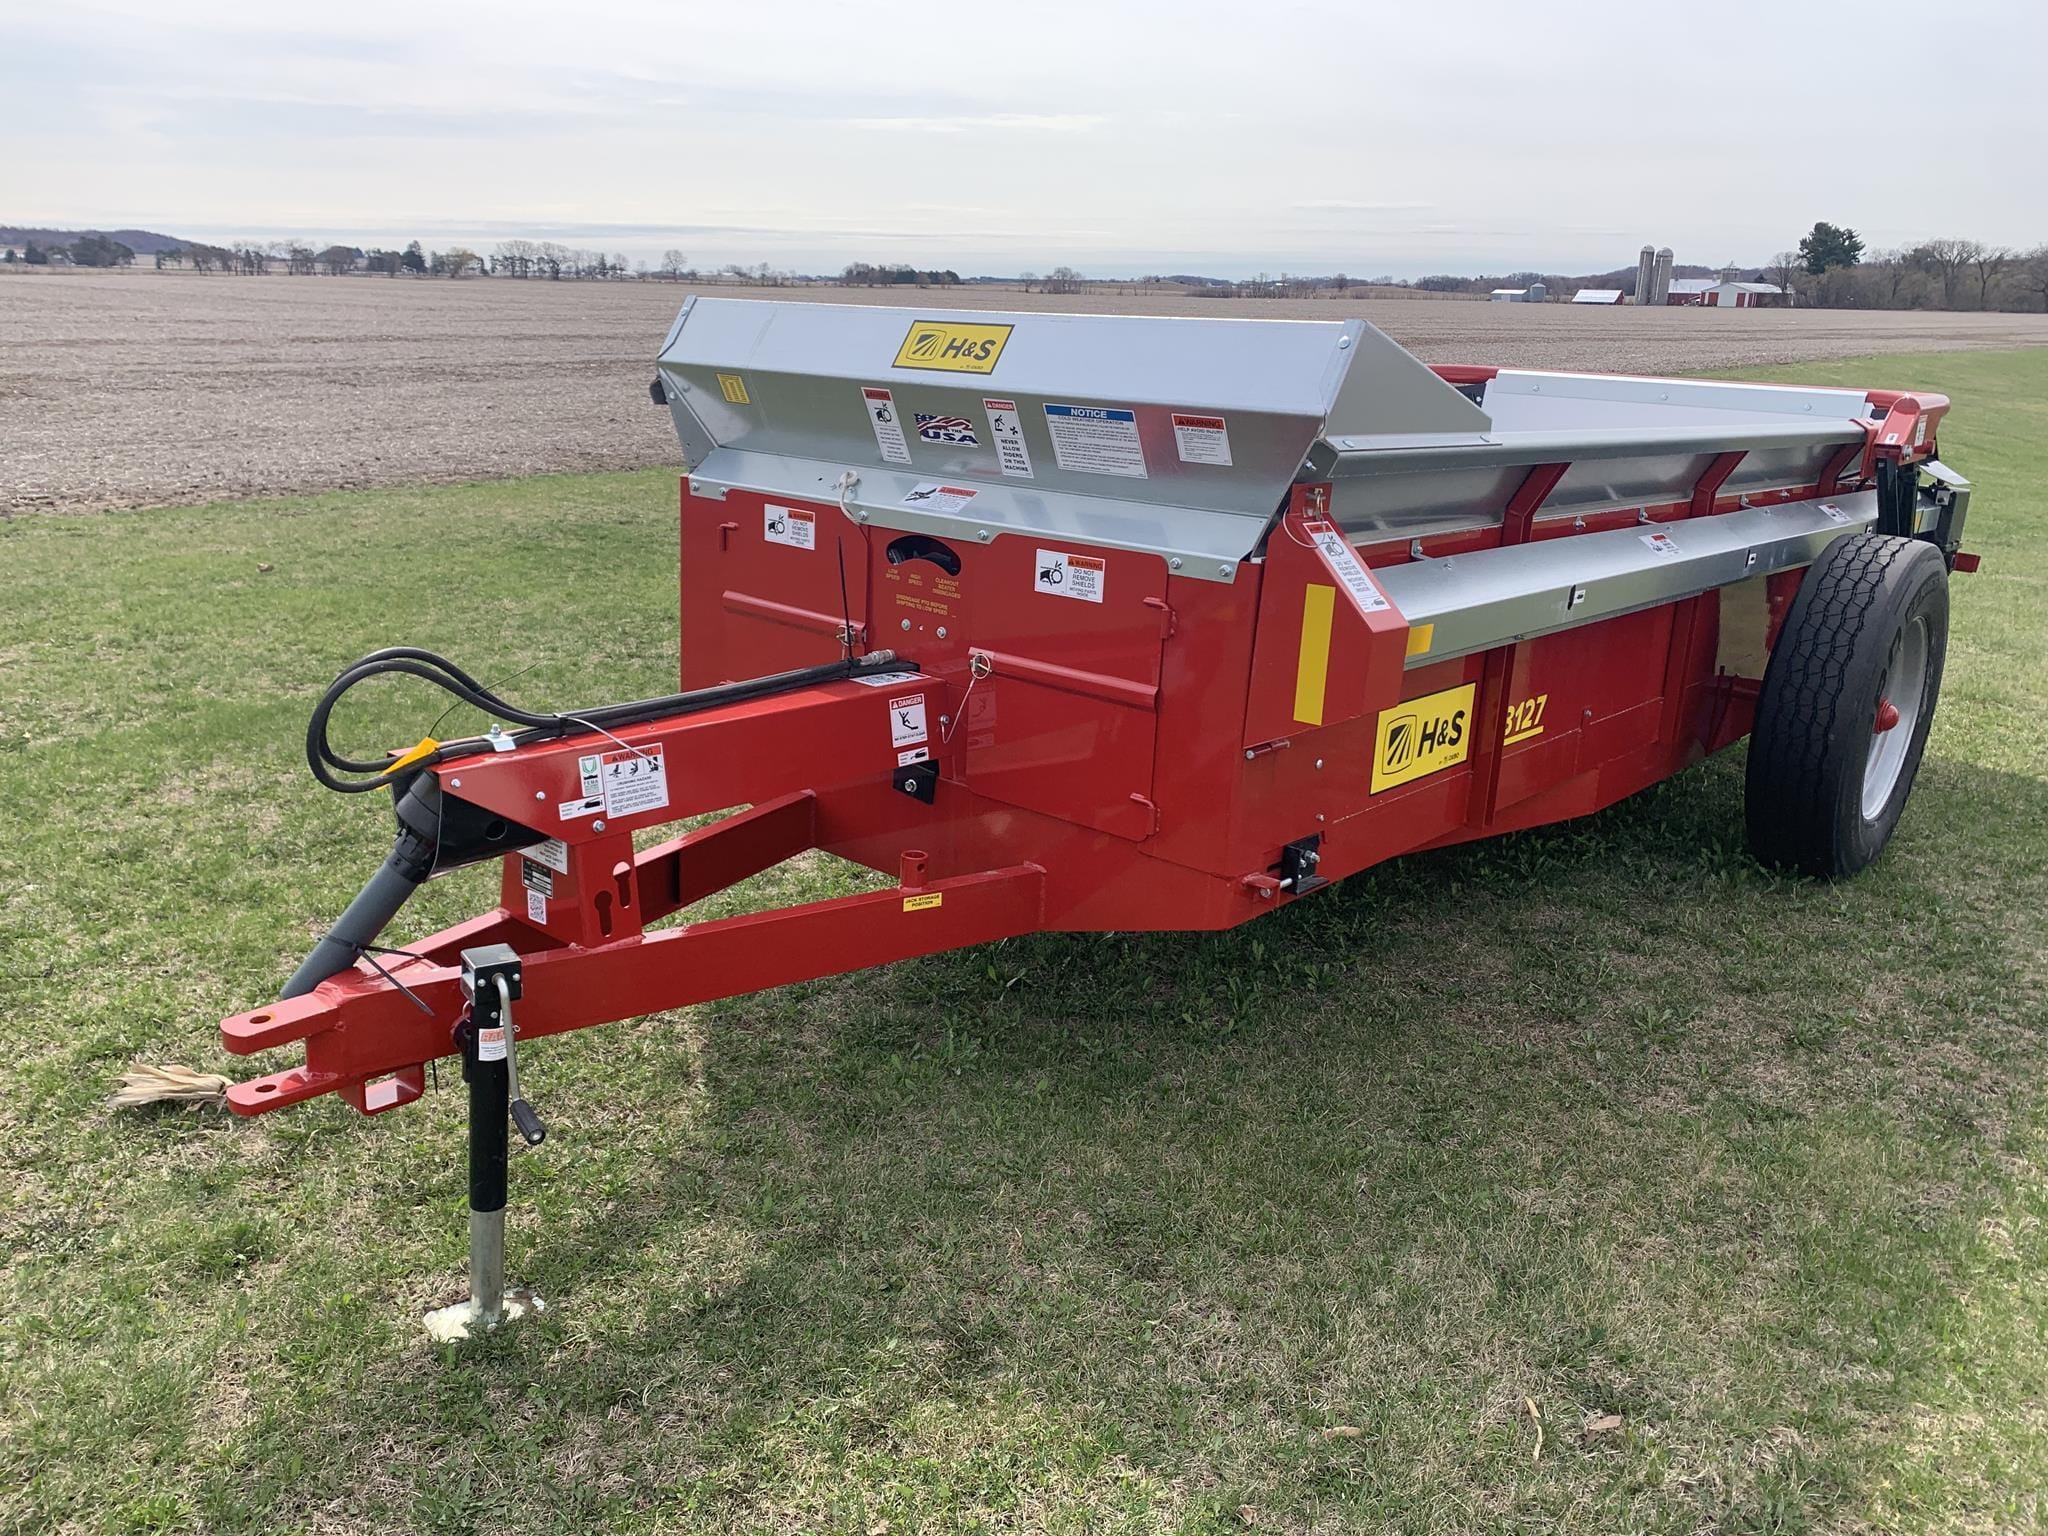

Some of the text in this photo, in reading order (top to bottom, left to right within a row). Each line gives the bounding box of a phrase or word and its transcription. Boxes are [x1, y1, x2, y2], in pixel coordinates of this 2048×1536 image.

[941, 337, 997, 361] H&S
[992, 402, 1014, 410] DANGER
[1070, 407, 1108, 419] NOTICE
[920, 429, 979, 445] USA
[1000, 438, 1019, 446] NEVER
[1003, 451, 1024, 459] RIDERS
[1004, 464, 1029, 472] MACHINE
[1072, 574, 1096, 583] REMOVE
[1072, 580, 1096, 589] SHIELDS
[898, 696, 922, 707] DANGER
[1417, 709, 1466, 758] H&S
